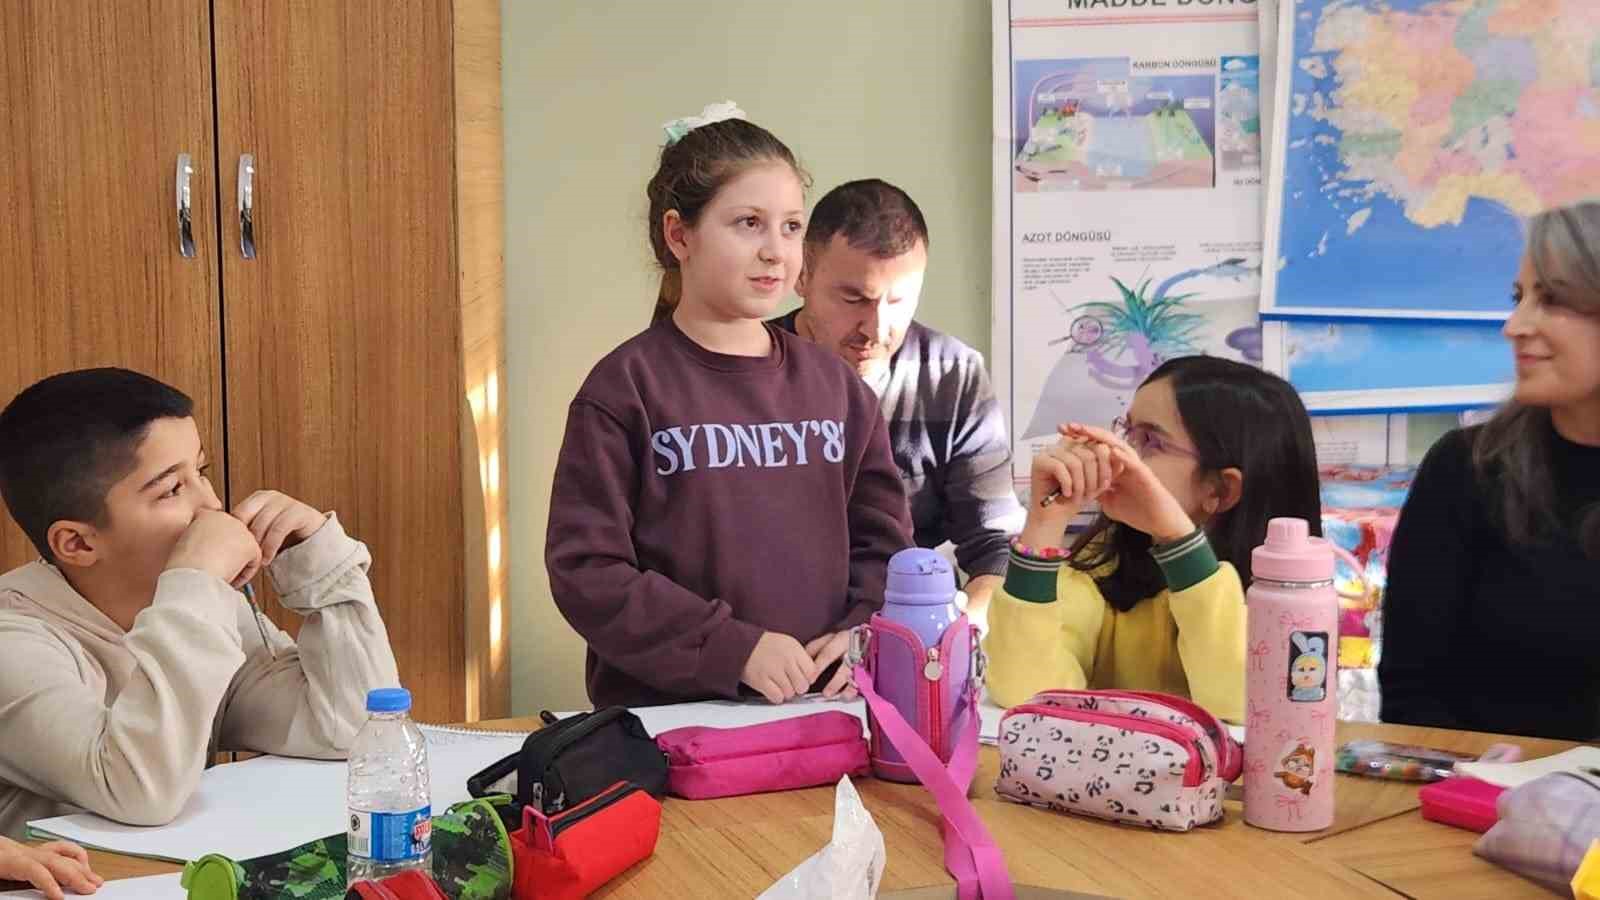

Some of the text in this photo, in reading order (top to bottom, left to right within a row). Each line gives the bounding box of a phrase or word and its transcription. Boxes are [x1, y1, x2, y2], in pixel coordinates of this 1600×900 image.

[1022, 229, 1111, 242] AZOT DÖNGÜSÜ
[651, 419, 845, 476] SYDNEY'8
